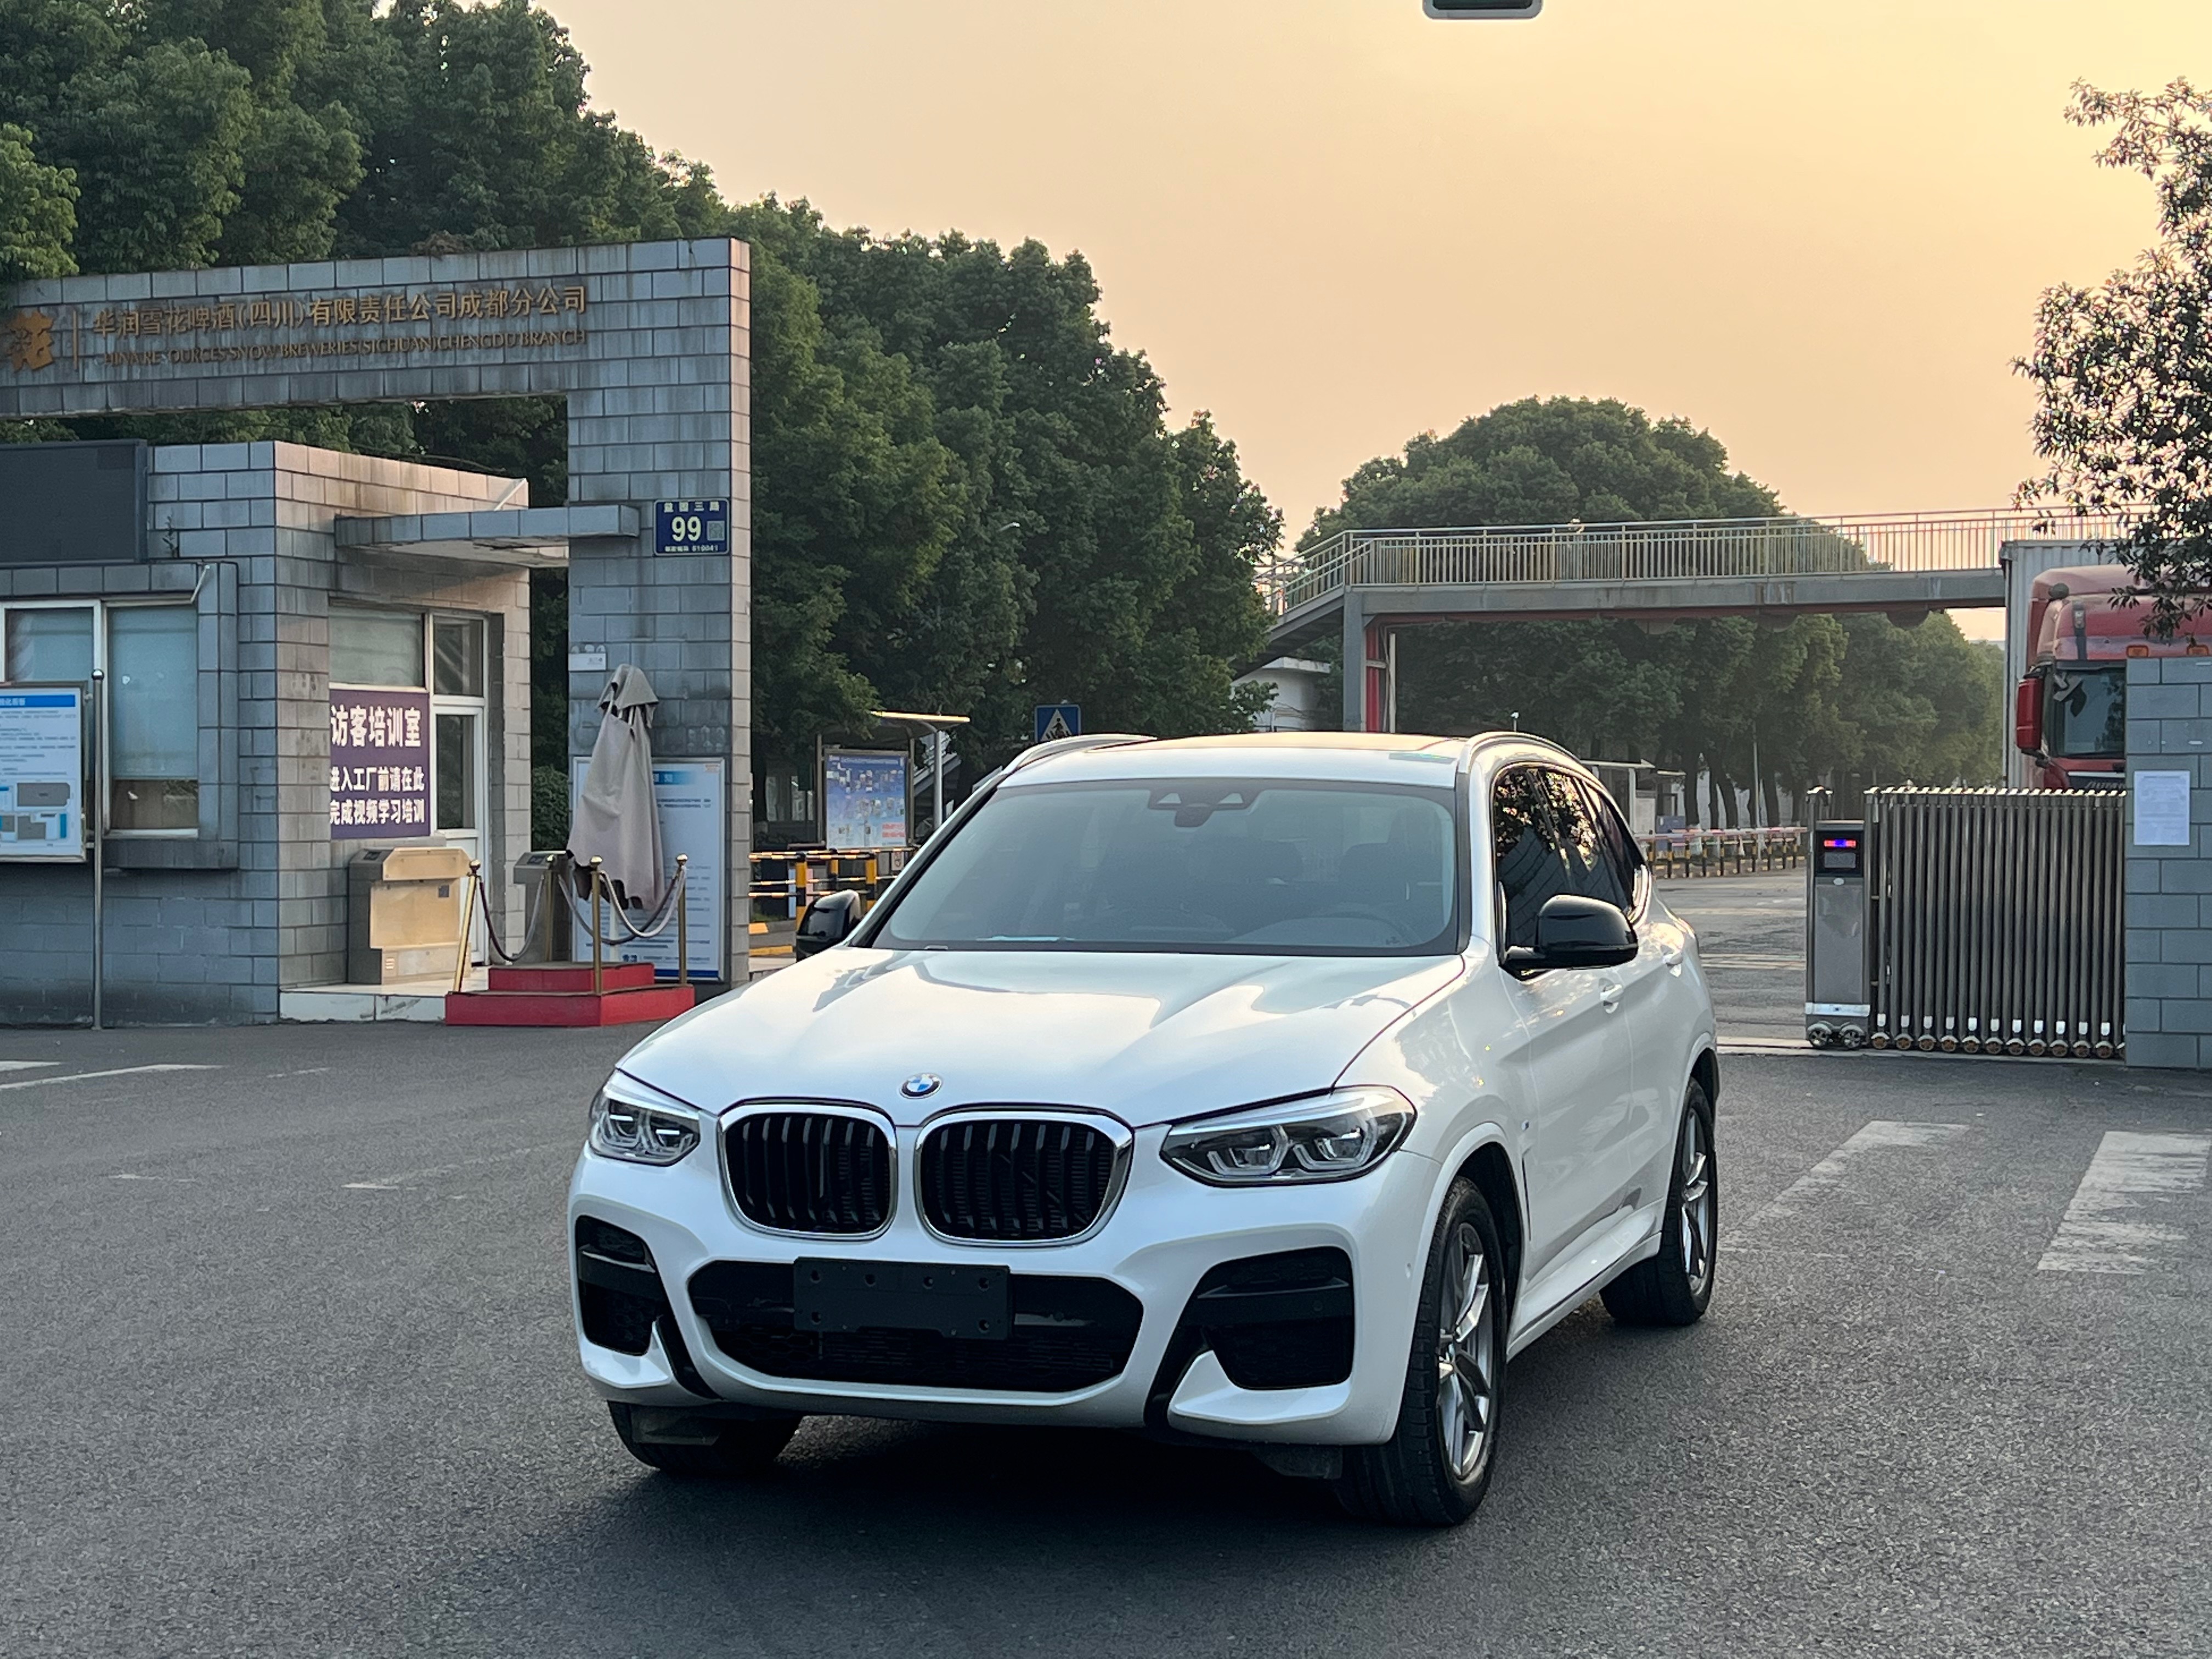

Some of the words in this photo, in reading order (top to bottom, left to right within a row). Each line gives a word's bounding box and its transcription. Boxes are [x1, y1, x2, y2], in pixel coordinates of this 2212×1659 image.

[93, 285, 586, 338] 华润雪花啤酒(四川)有限责任公司成都分公司
[229, 344, 277, 360] SNOW
[521, 329, 586, 347] BRANCH
[672, 516, 702, 542] 99
[330, 704, 422, 748] 访客培训室
[330, 766, 425, 792] 进入工厂前请在此
[330, 798, 425, 825] 完成视频学习培训
